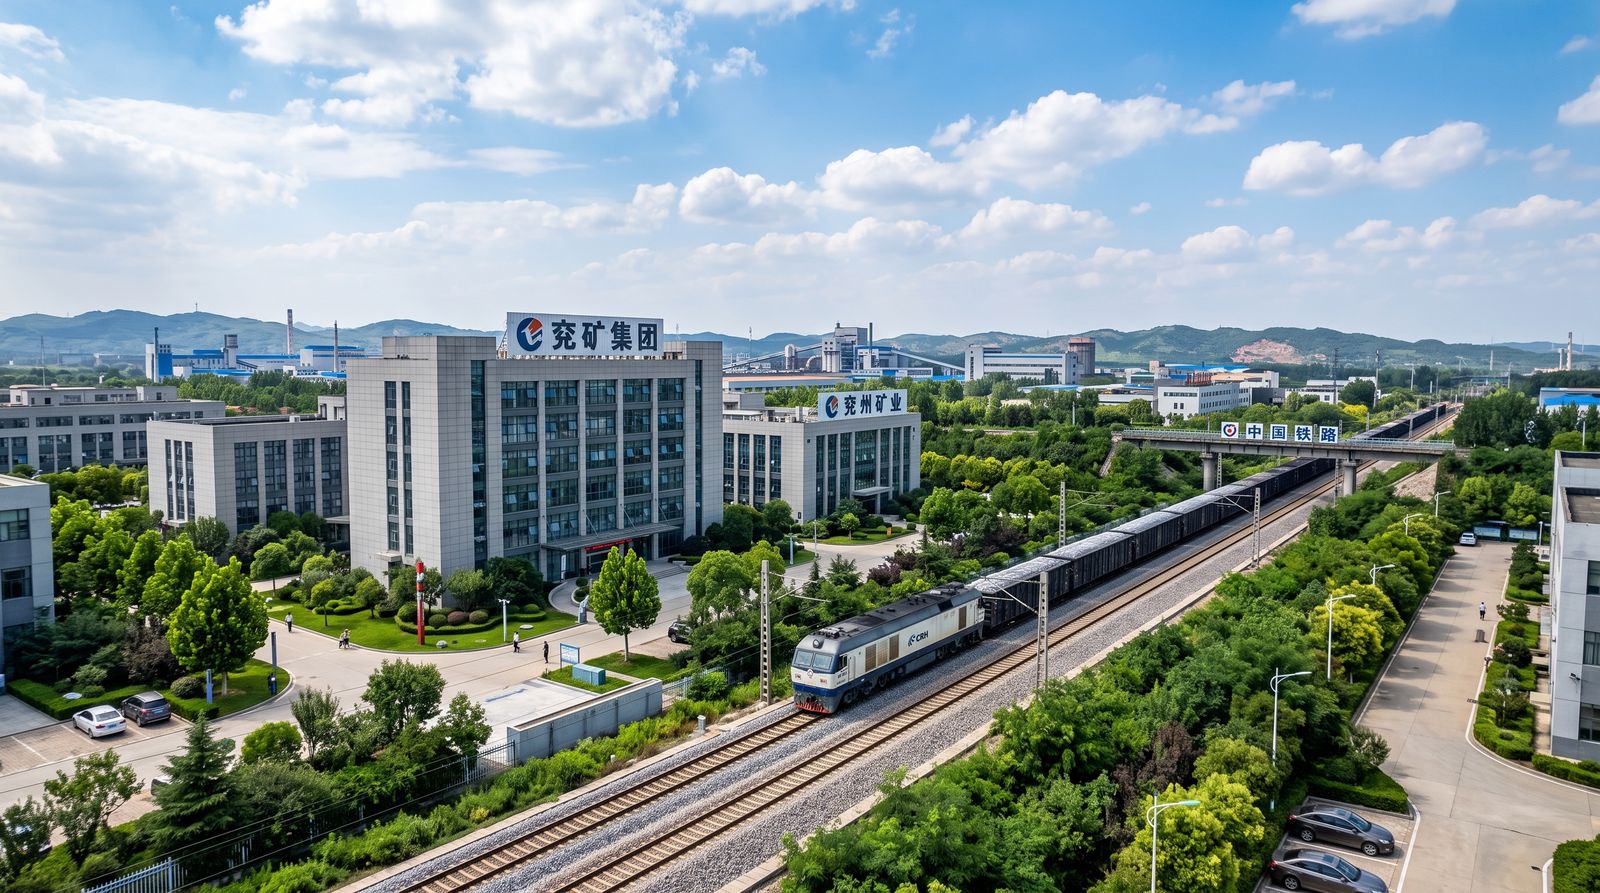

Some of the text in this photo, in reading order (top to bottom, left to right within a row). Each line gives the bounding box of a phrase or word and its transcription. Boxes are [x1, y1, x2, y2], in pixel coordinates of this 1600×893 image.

[551, 319, 658, 351] 兖矿集团
[844, 393, 902, 416] 兖州矿业
[1248, 425, 1337, 442] 中国铁路
[916, 630, 929, 642] CRH
